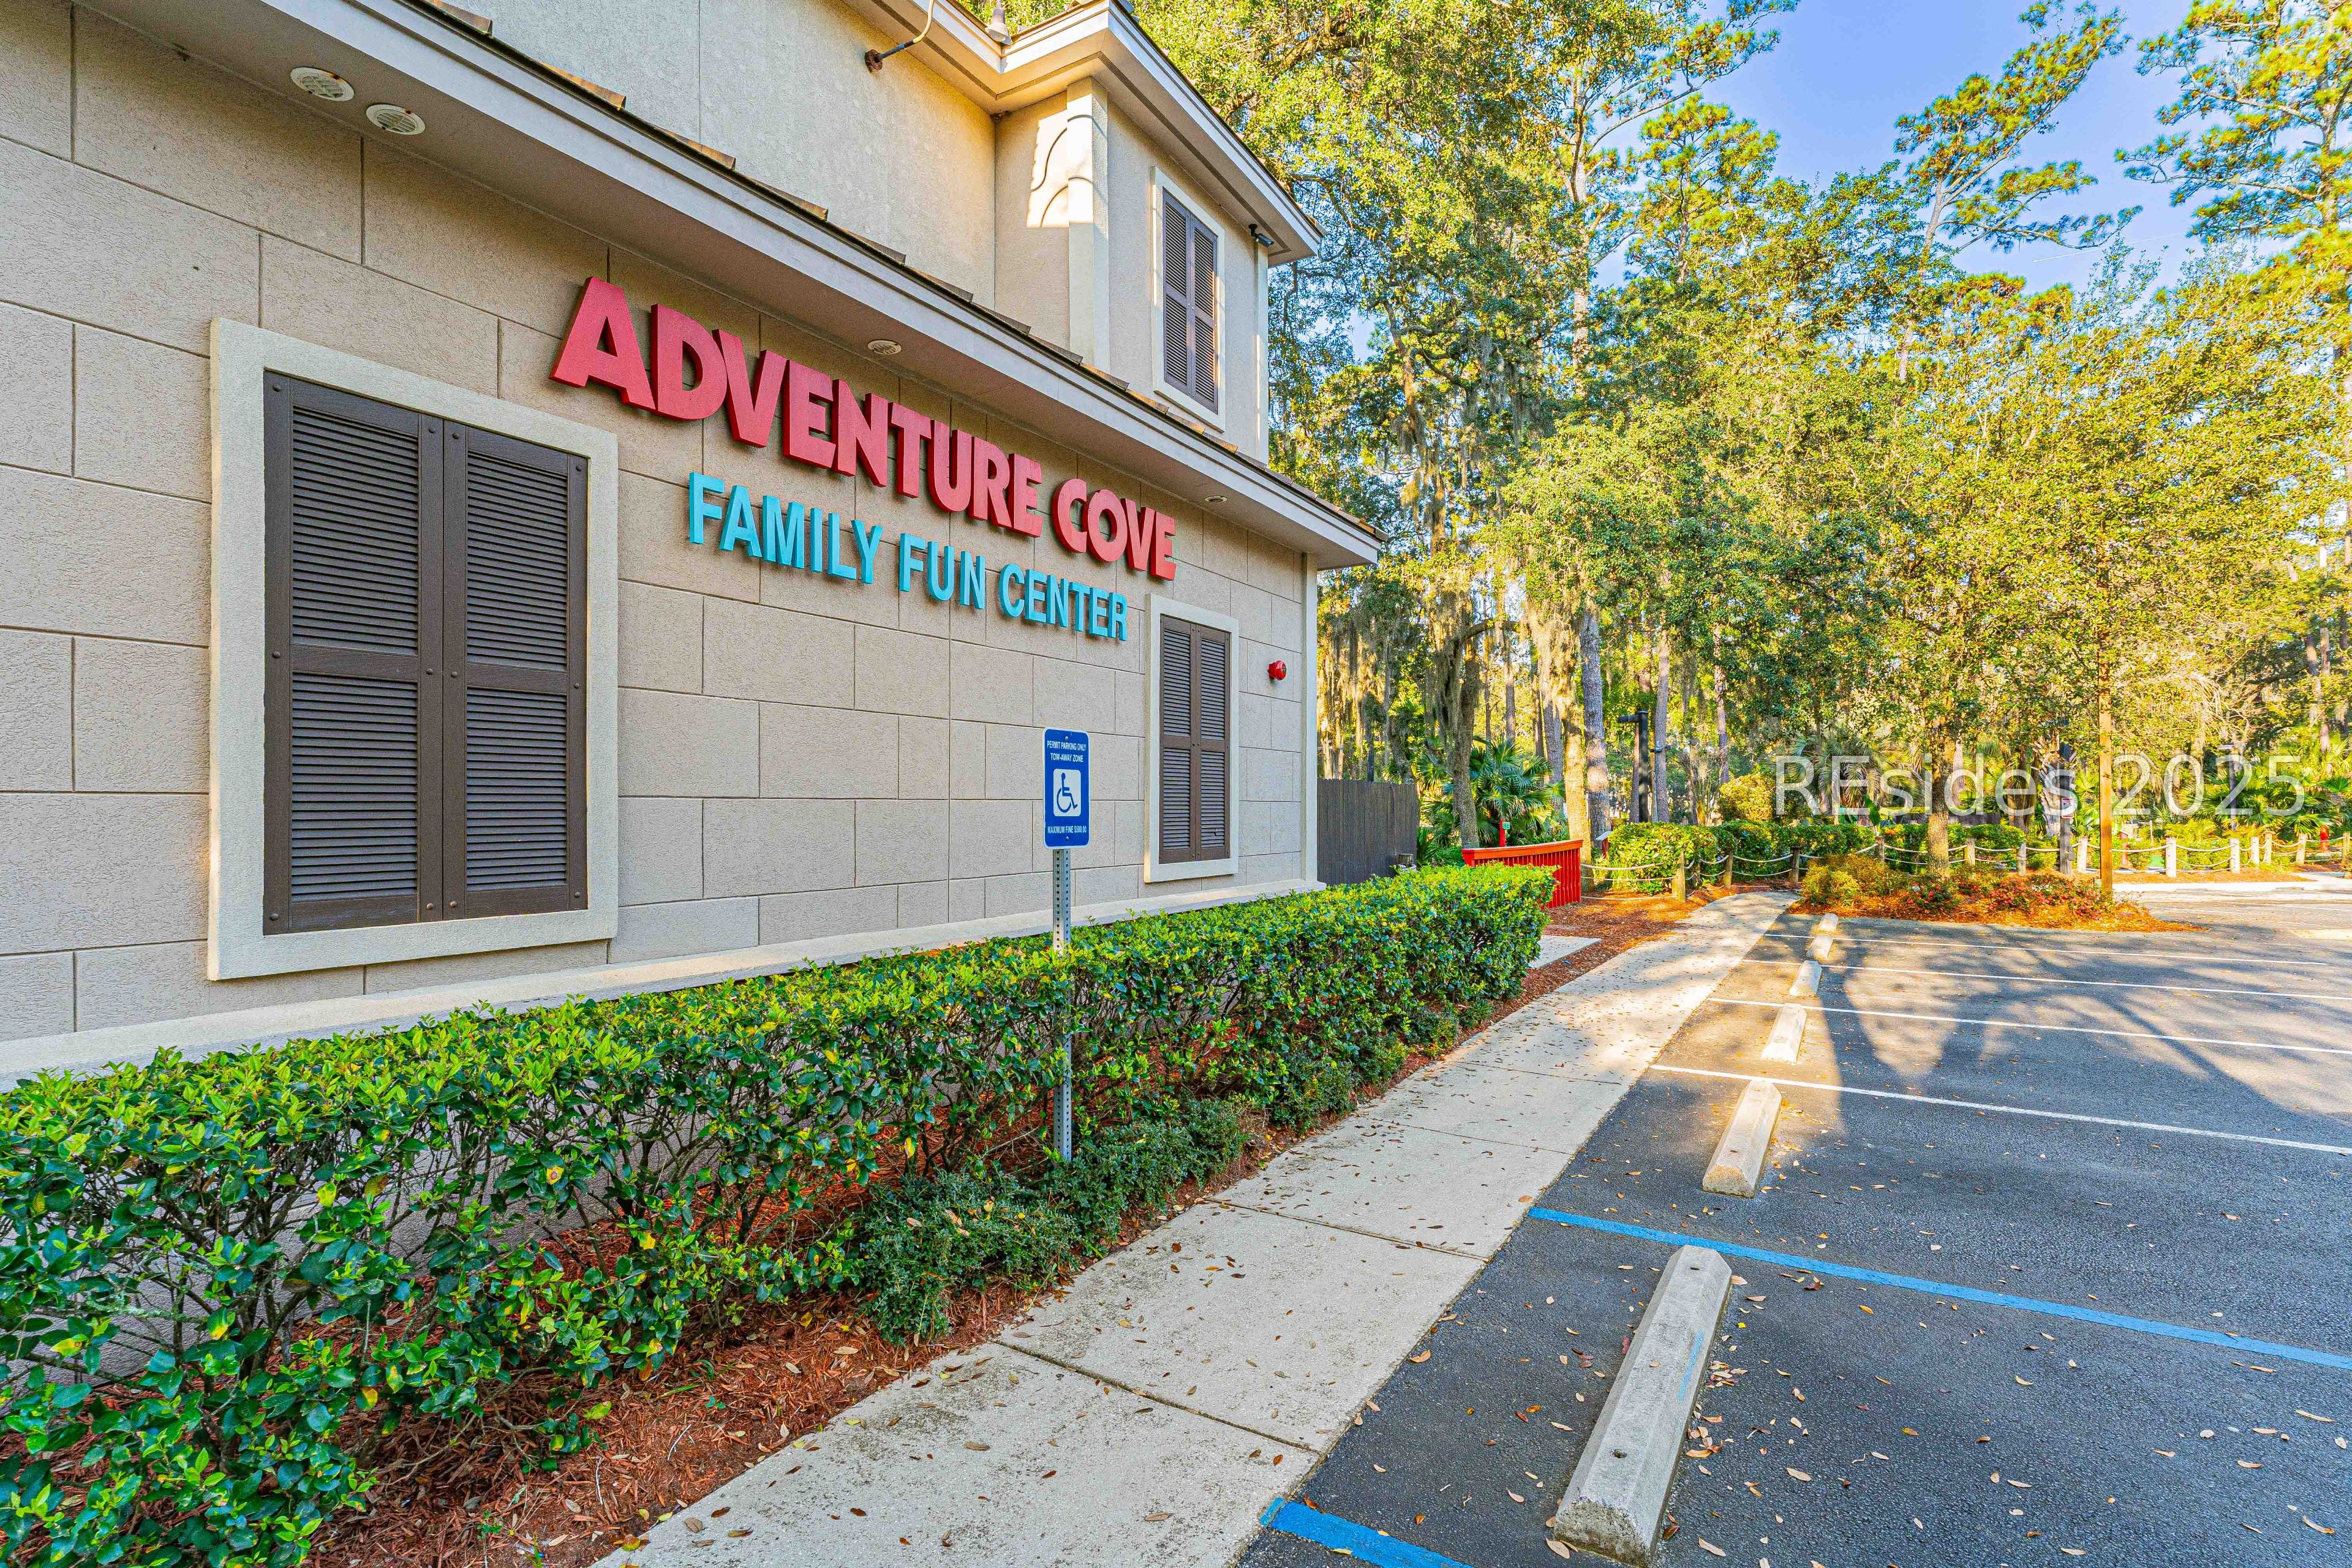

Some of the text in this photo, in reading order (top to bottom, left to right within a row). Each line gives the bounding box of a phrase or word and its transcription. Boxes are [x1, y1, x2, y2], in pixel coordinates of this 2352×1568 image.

[551, 276, 1177, 581] ADVENTURE COVE
[688, 472, 1128, 641] FAMILY FUN CENTER
[1047, 741, 1061, 749] PERMIT
[1061, 742, 1077, 750] PARKING
[1050, 753, 1072, 762] TOW-AWAY
